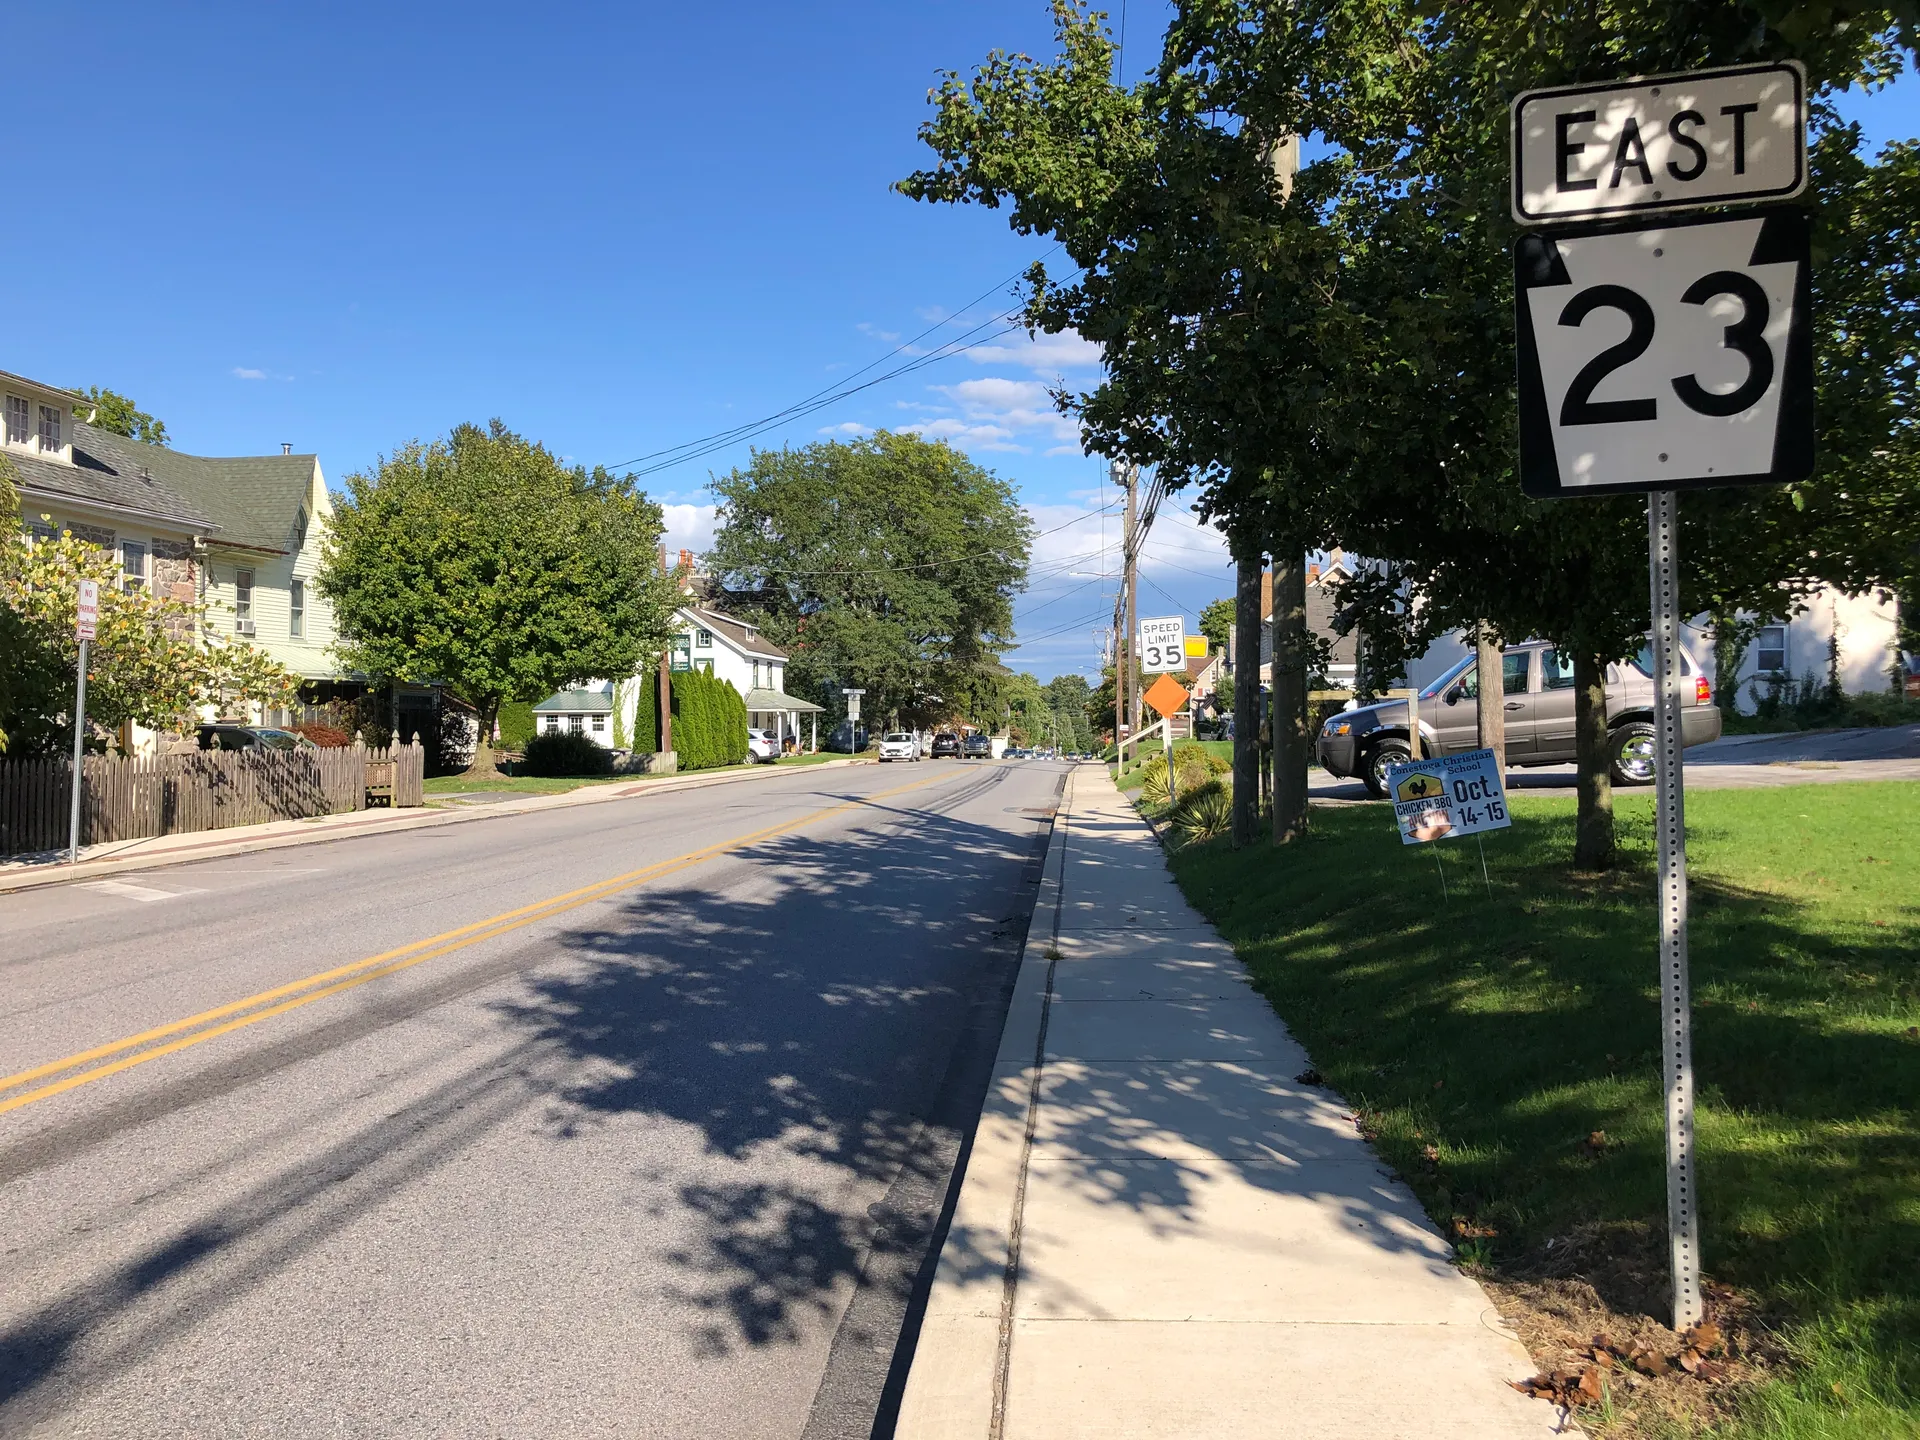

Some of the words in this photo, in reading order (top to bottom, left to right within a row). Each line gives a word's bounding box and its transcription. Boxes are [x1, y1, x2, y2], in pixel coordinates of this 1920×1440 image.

[1555, 102, 1759, 194] EAST
[1556, 270, 1774, 427] 23
[85, 589, 92, 598] NO
[79, 604, 96, 614] PARKING
[1143, 623, 1180, 633] SPEED
[1148, 634, 1176, 644] LIMIT
[1146, 645, 1182, 666] 35
[1390, 762, 1440, 775] Conestoga
[1443, 752, 1492, 766] Christian
[1447, 762, 1481, 774] School
[1453, 775, 1499, 803] Oct.
[1396, 800, 1433, 815] CHICKEN
[1435, 796, 1453, 809] BBQ
[1457, 801, 1504, 827] 14-15
